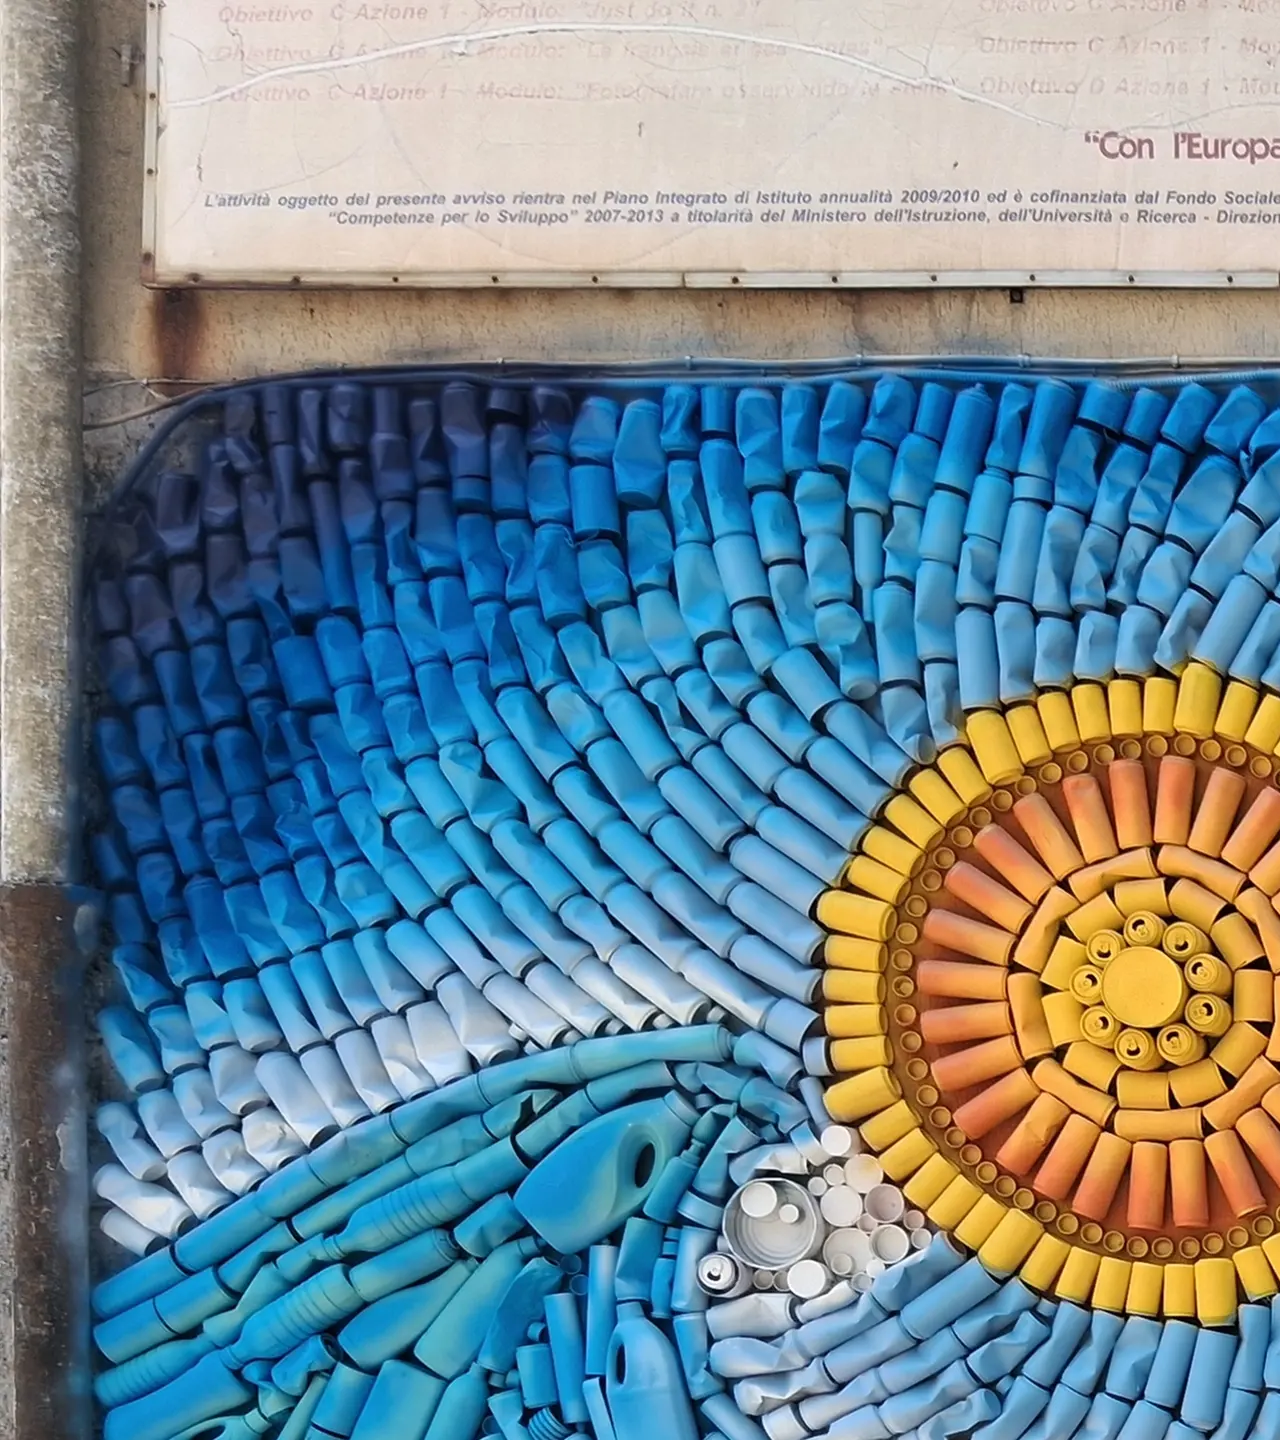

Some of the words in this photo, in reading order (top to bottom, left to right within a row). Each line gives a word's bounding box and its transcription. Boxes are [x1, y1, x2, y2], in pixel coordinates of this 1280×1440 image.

[219, 4, 313, 23] Obiettivo
[330, 3, 345, 21] C
[354, 3, 428, 21] Azione
[1083, 127, 1159, 160] “Con
[203, 188, 271, 208] L'attività
[277, 193, 339, 209] oggetto
[345, 192, 371, 207] del
[375, 192, 447, 209] presente
[451, 190, 506, 205] avviso
[511, 190, 566, 206] rientra
[571, 190, 598, 205] nel
[602, 190, 650, 205] Piano
[655, 190, 728, 208] Integrato
[733, 190, 751, 205] di
[755, 189, 813, 205] Istituto
[818, 188, 893, 205] annualità
[900, 188, 981, 204] 2009/2010
[983, 189, 1008, 205] ed
[1013, 188, 1024, 204] è
[1029, 188, 1127, 205] cofinanziata
[1134, 189, 1160, 205] dal
[1165, 189, 1217, 206] Fondo
[328, 210, 435, 227] “Competenze
[440, 212, 470, 227] per
[474, 209, 491, 224] lo
[496, 208, 579, 227] Sviluppo”
[584, 208, 665, 224] 2007-2013
[670, 211, 680, 223] a
[687, 208, 754, 224] titolarità
[759, 208, 786, 224] del
[791, 208, 867, 224] Ministero
[873, 208, 991, 224] dell'Istruzione,
[997, 208, 1113, 224] dell'Università
[1119, 212, 1130, 224] e
[1136, 208, 1197, 225] Ricerca
